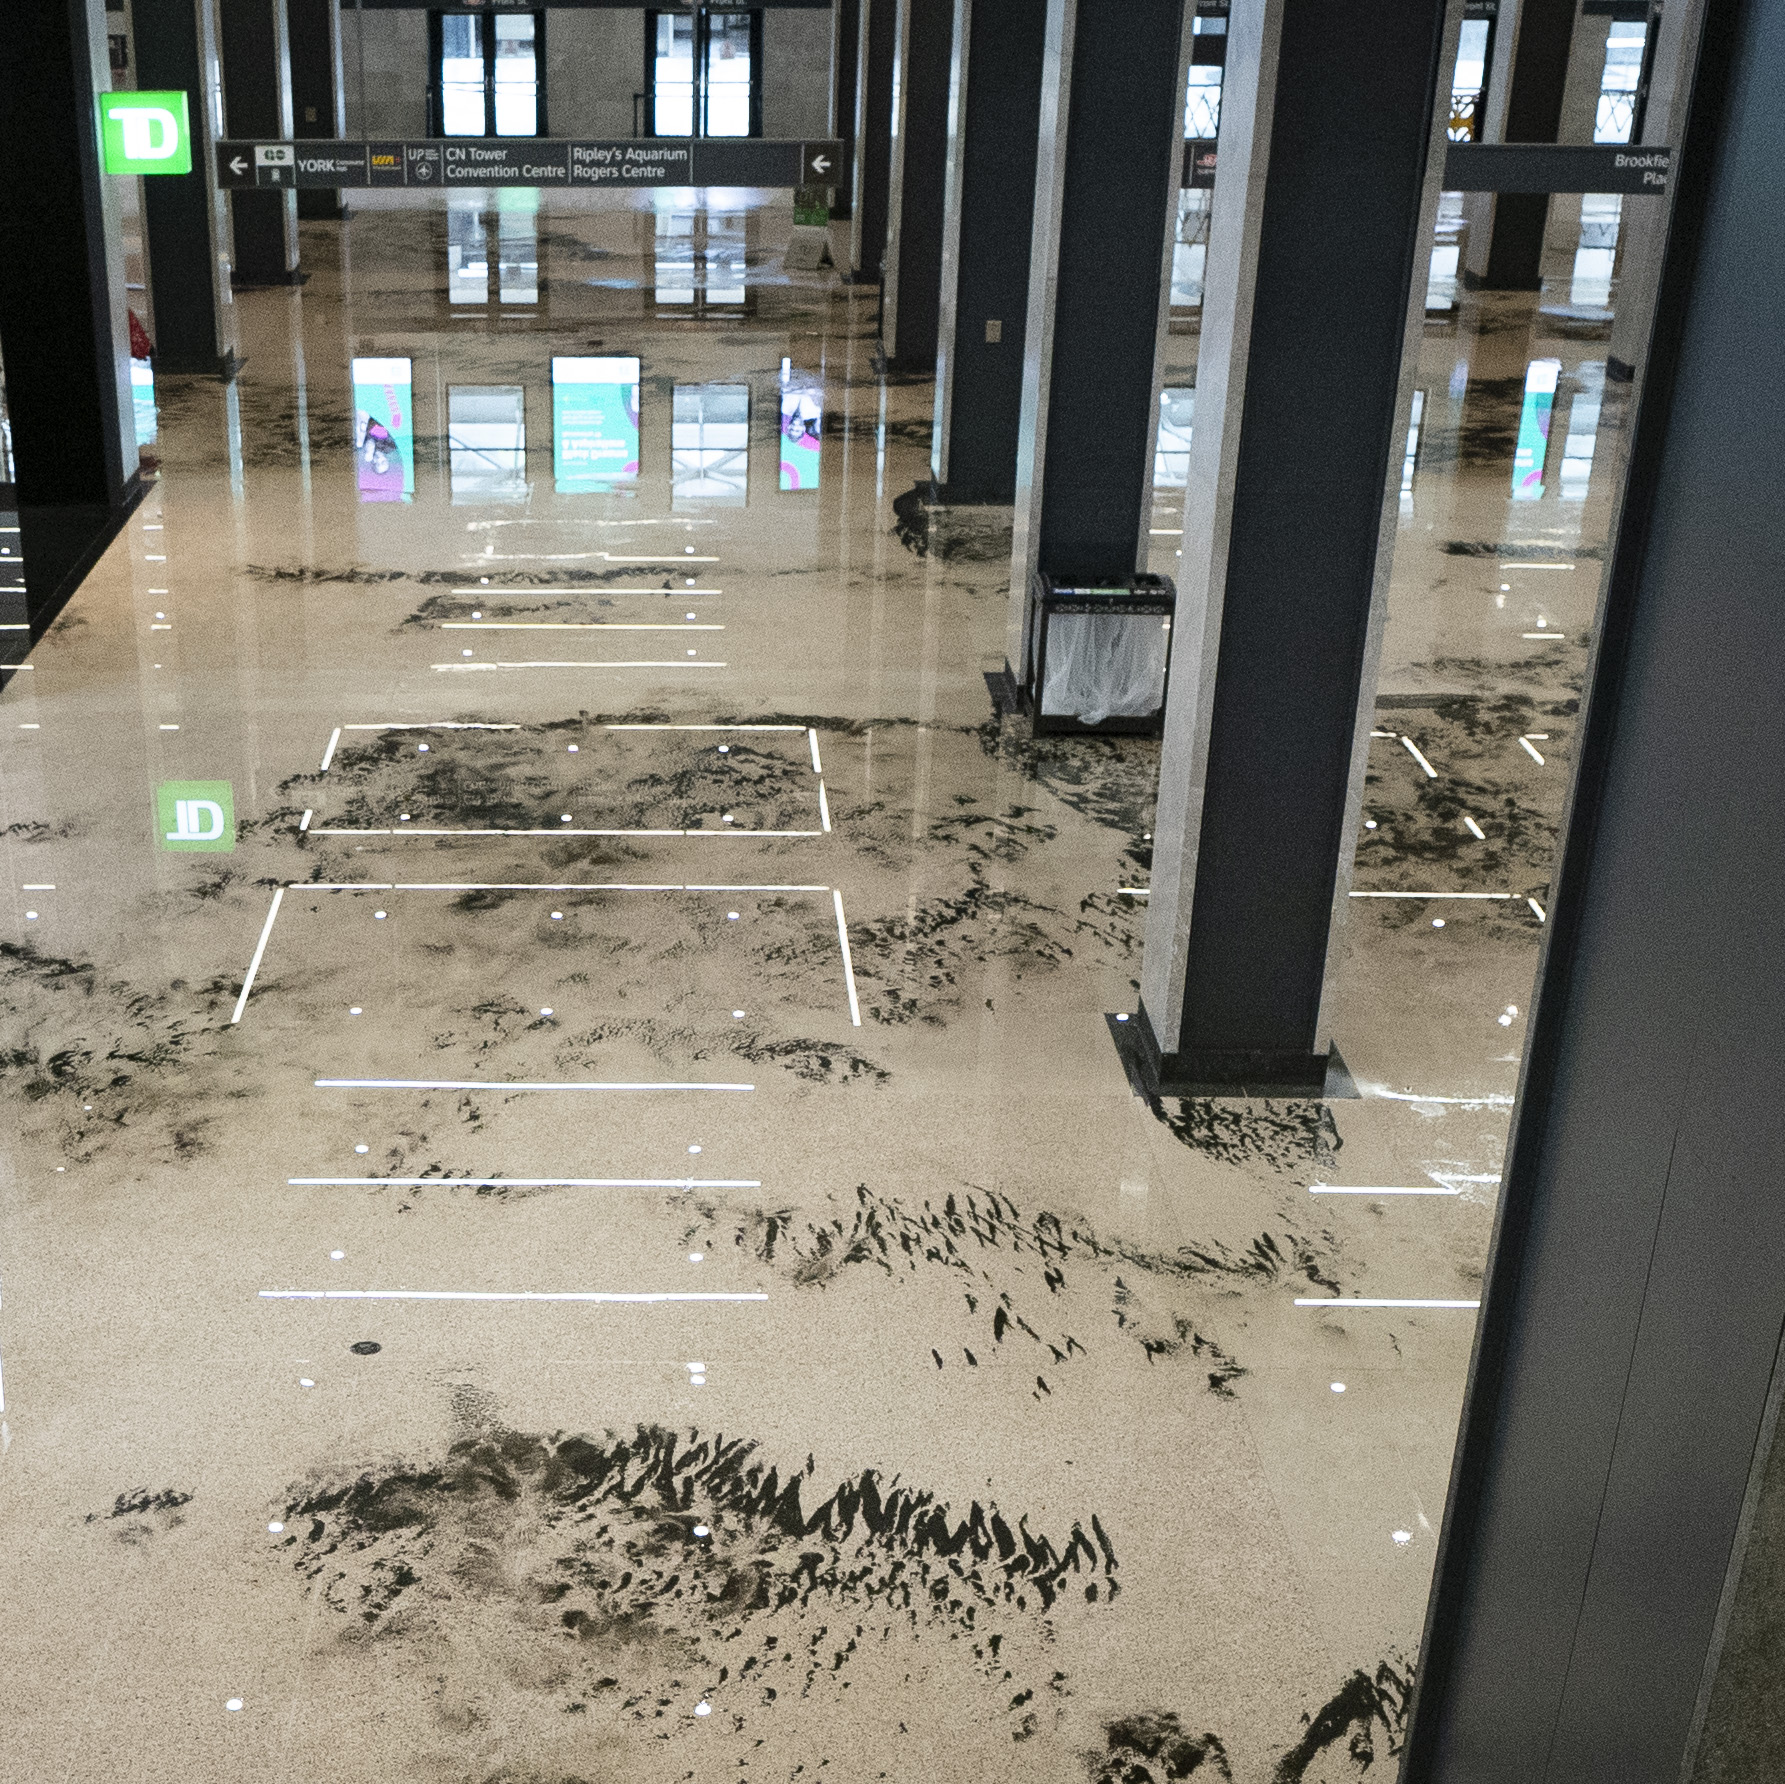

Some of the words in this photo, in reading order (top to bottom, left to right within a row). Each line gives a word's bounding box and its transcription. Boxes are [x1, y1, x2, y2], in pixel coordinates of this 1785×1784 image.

[108, 107, 179, 160] TD
[408, 149, 424, 160] UP
[446, 148, 465, 161] CN
[468, 148, 507, 161] Tower
[573, 147, 622, 163] Ripley's
[626, 148, 688, 163] Aquarium
[297, 159, 335, 172] YORK
[446, 165, 519, 178] Convention
[523, 165, 566, 178] Centre
[573, 165, 618, 180] Rogers
[622, 165, 665, 178] Centre
